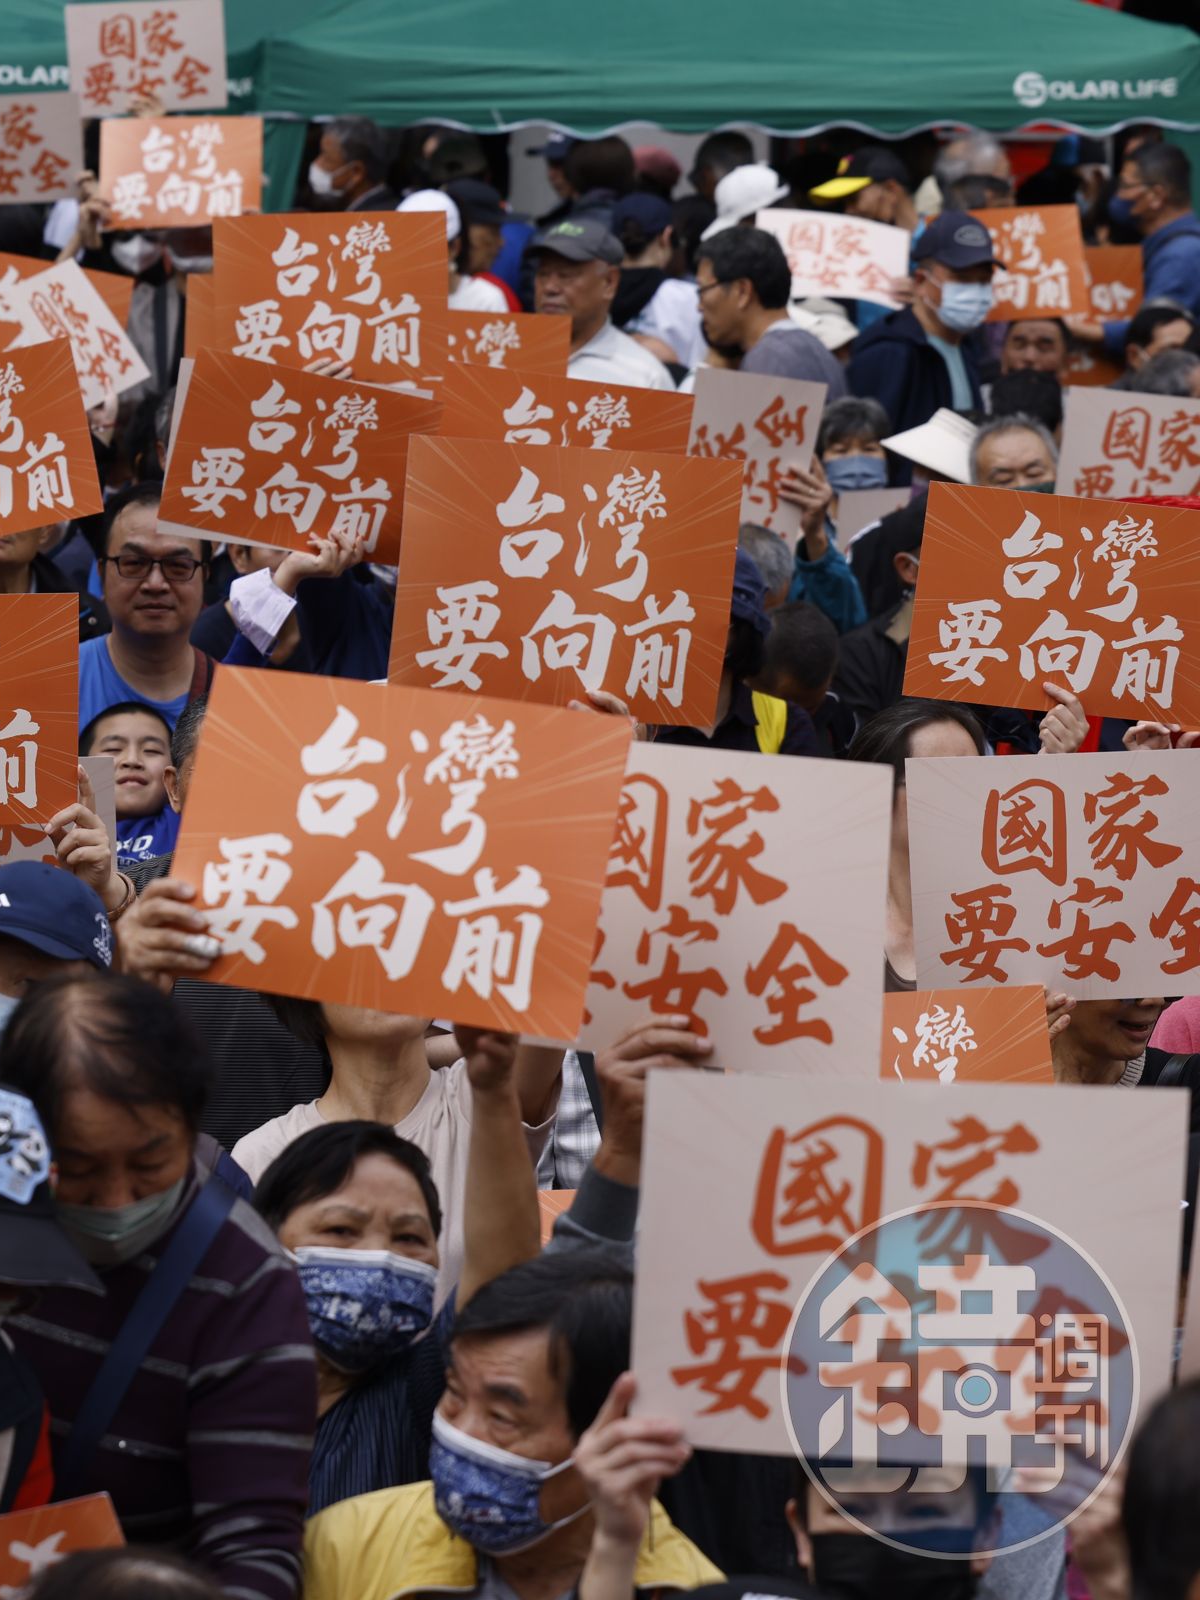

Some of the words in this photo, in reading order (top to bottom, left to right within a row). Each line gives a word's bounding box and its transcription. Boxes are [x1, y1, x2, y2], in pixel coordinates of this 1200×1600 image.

[83, 57, 212, 106] 要安全
[99, 10, 184, 60] 國家
[1013, 71, 1120, 107] SOLAR
[1124, 77, 1179, 99] LIFE
[111, 170, 243, 219] 要向前
[139, 122, 223, 180] 台灣
[271, 221, 391, 304] 台灣
[788, 220, 869, 255] 國家
[231, 294, 421, 367] 要向前
[248, 379, 380, 480] 台灣
[181, 447, 392, 554] 要向前
[496, 466, 667, 602] 台灣
[1002, 510, 1158, 622] 台灣
[415, 580, 696, 708] 要向前
[929, 600, 1184, 709] 要向前
[297, 705, 520, 875] 台灣
[981, 772, 1184, 886] 國家
[203, 833, 550, 1012] 要向前
[751, 1114, 1051, 1280] 國家
